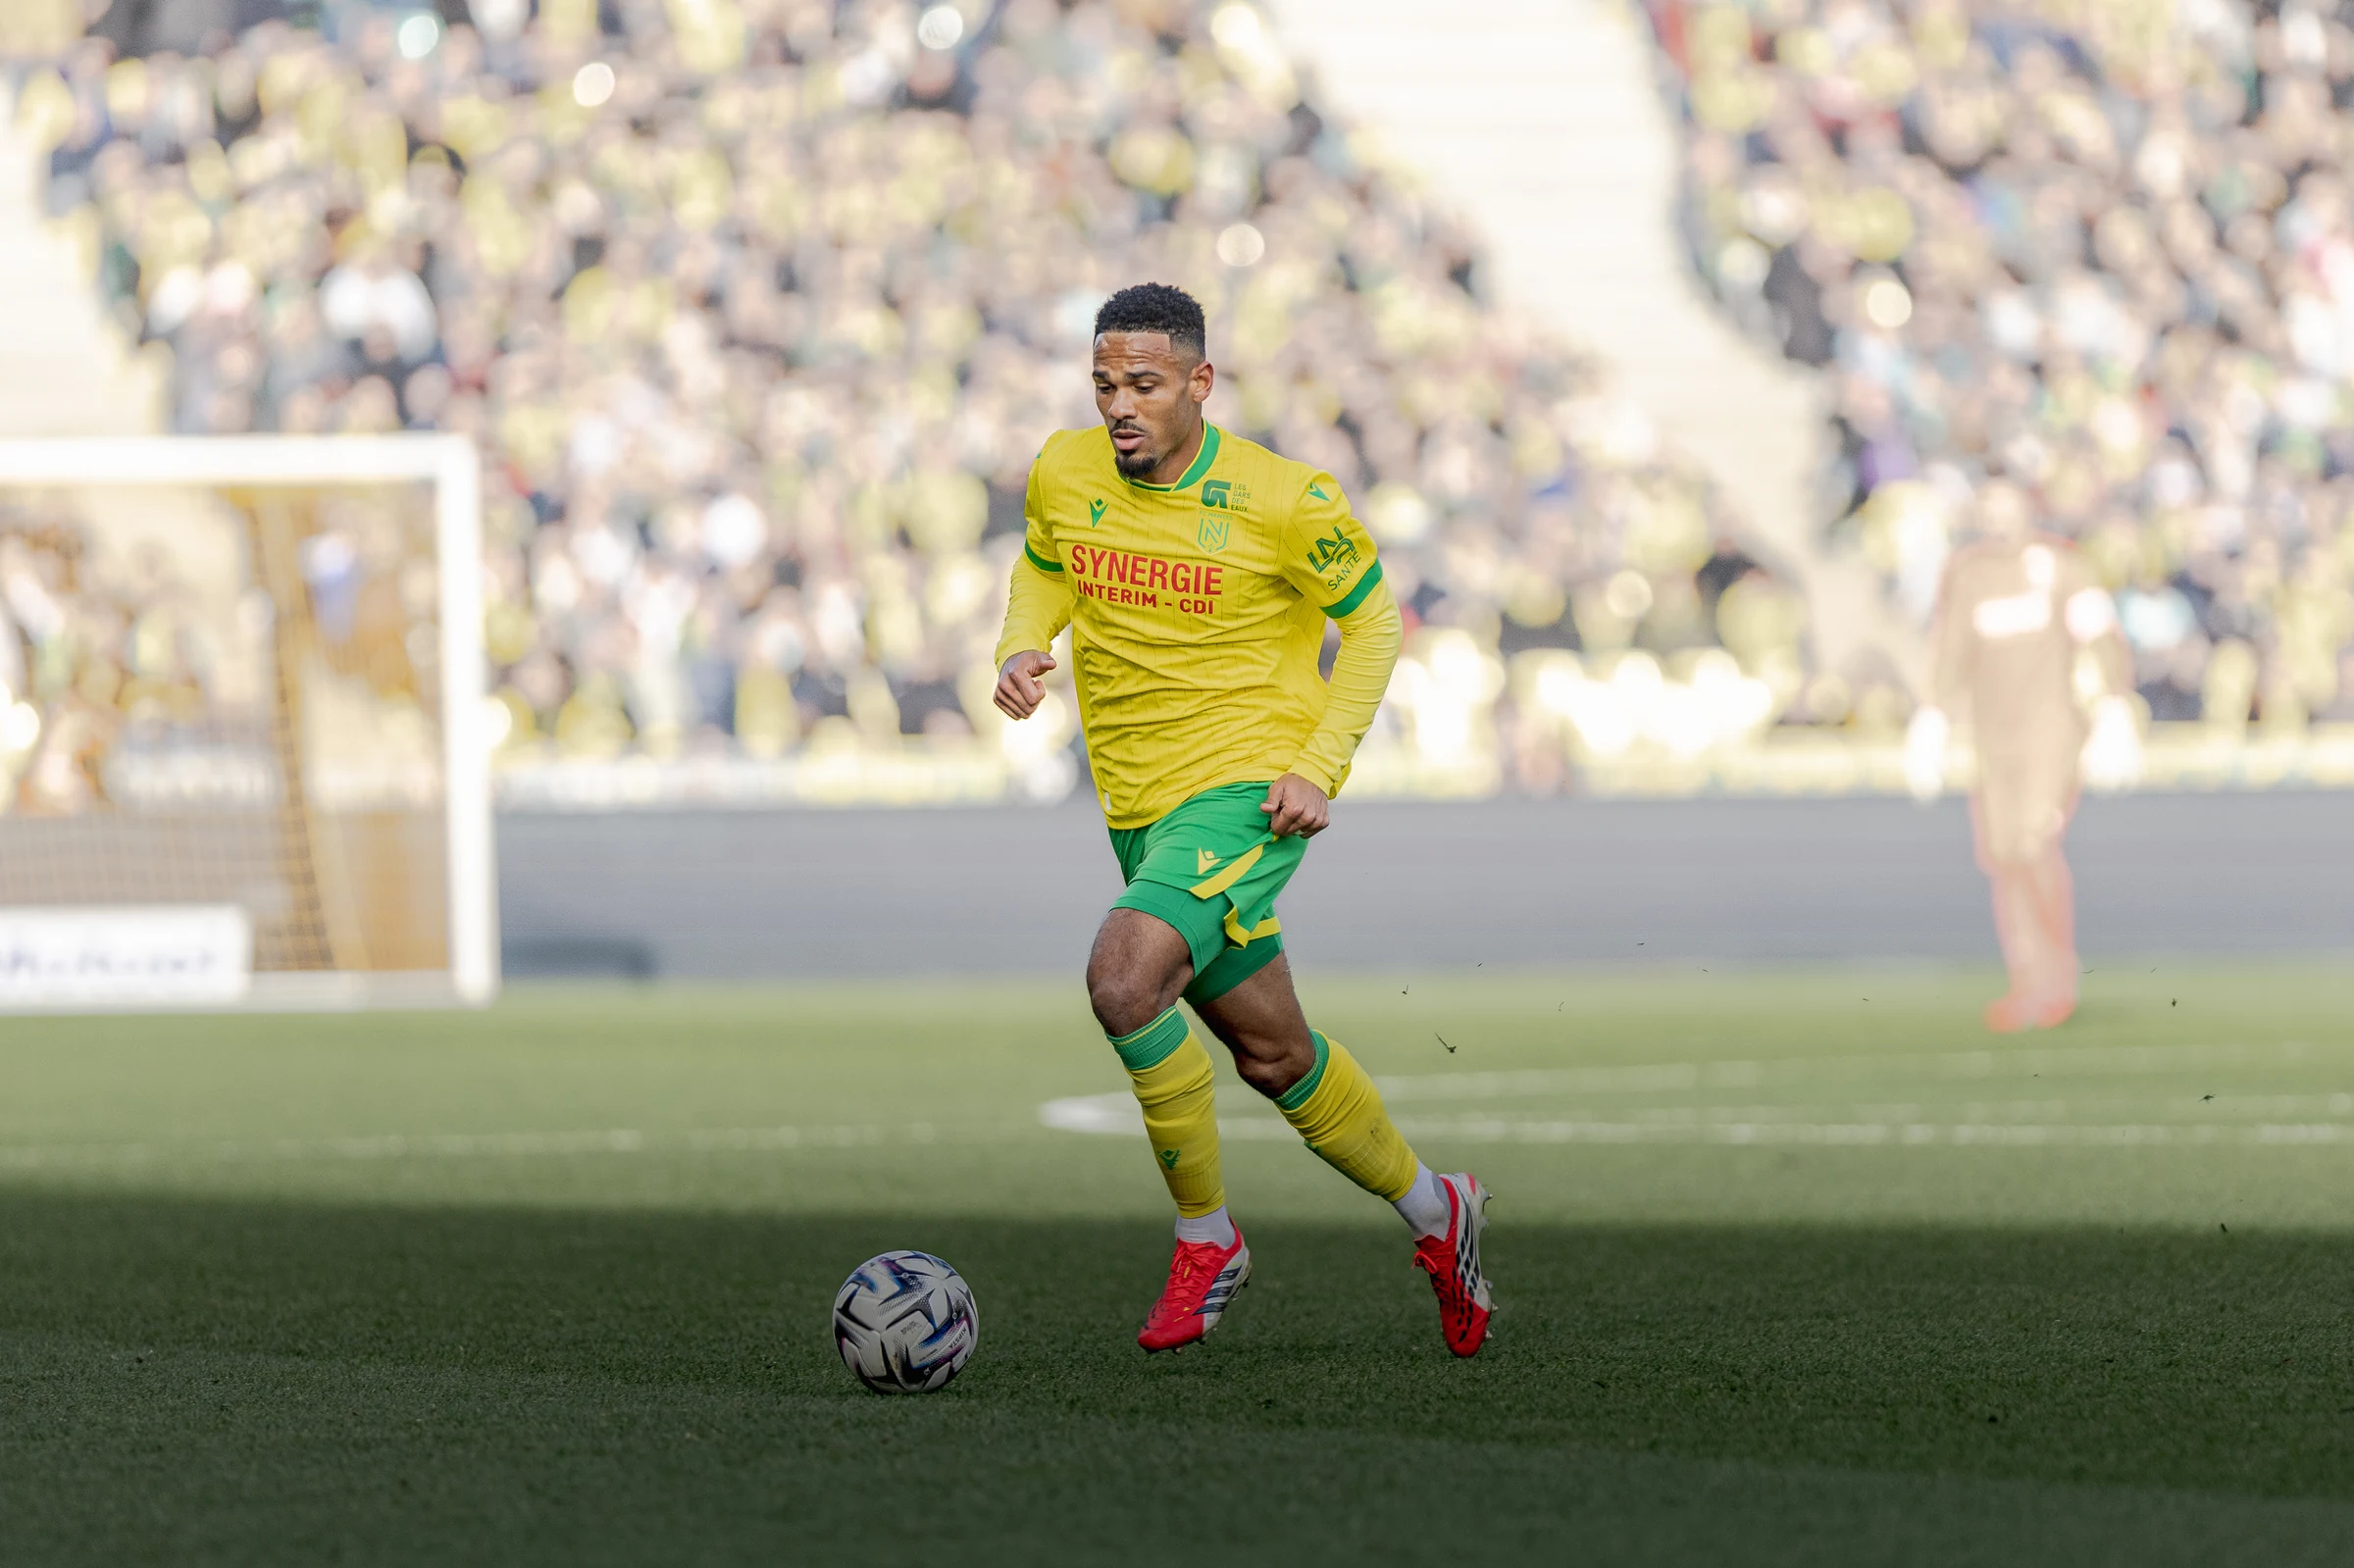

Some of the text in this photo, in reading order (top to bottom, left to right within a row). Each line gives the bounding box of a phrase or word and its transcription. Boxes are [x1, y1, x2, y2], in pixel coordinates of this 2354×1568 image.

[1207, 512, 1234, 521] NANTES
[1071, 544, 1223, 595] SYNERGIE
[1078, 579, 1157, 609] INTERIM
[1179, 598, 1214, 615] CDI
[947, 1327, 966, 1349] KIPSTA
